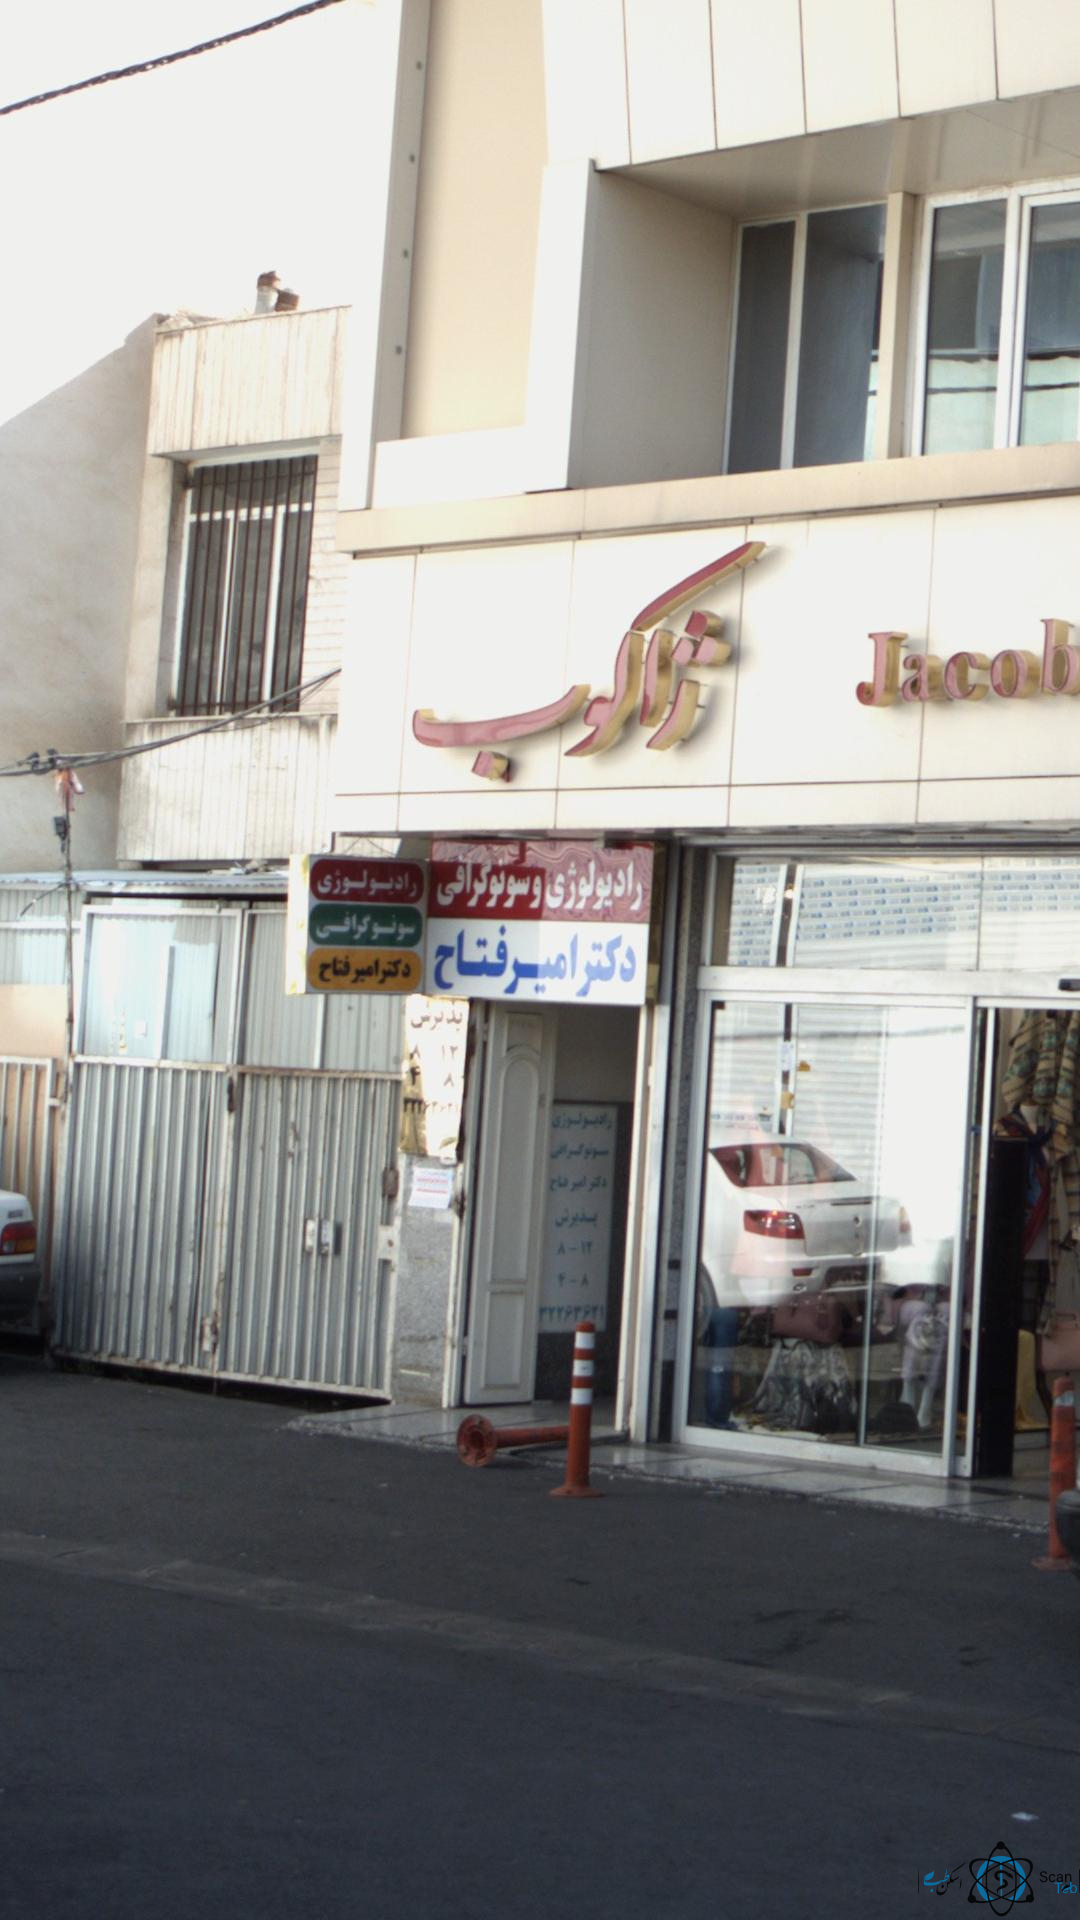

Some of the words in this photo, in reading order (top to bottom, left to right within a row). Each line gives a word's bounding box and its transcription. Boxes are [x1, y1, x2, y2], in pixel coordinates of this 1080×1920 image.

[856, 618, 1080, 707] Jacob
[317, 869, 417, 898] رادیولوژی
[545, 859, 643, 911] رادیولوژی
[315, 911, 416, 941] سونوگرافی
[318, 954, 351, 982] فتاح
[351, 957, 380, 984] امیر
[378, 957, 411, 984] دکتر
[434, 924, 507, 990] فتاح
[504, 933, 578, 994] امیر
[575, 934, 637, 997] دکتر
